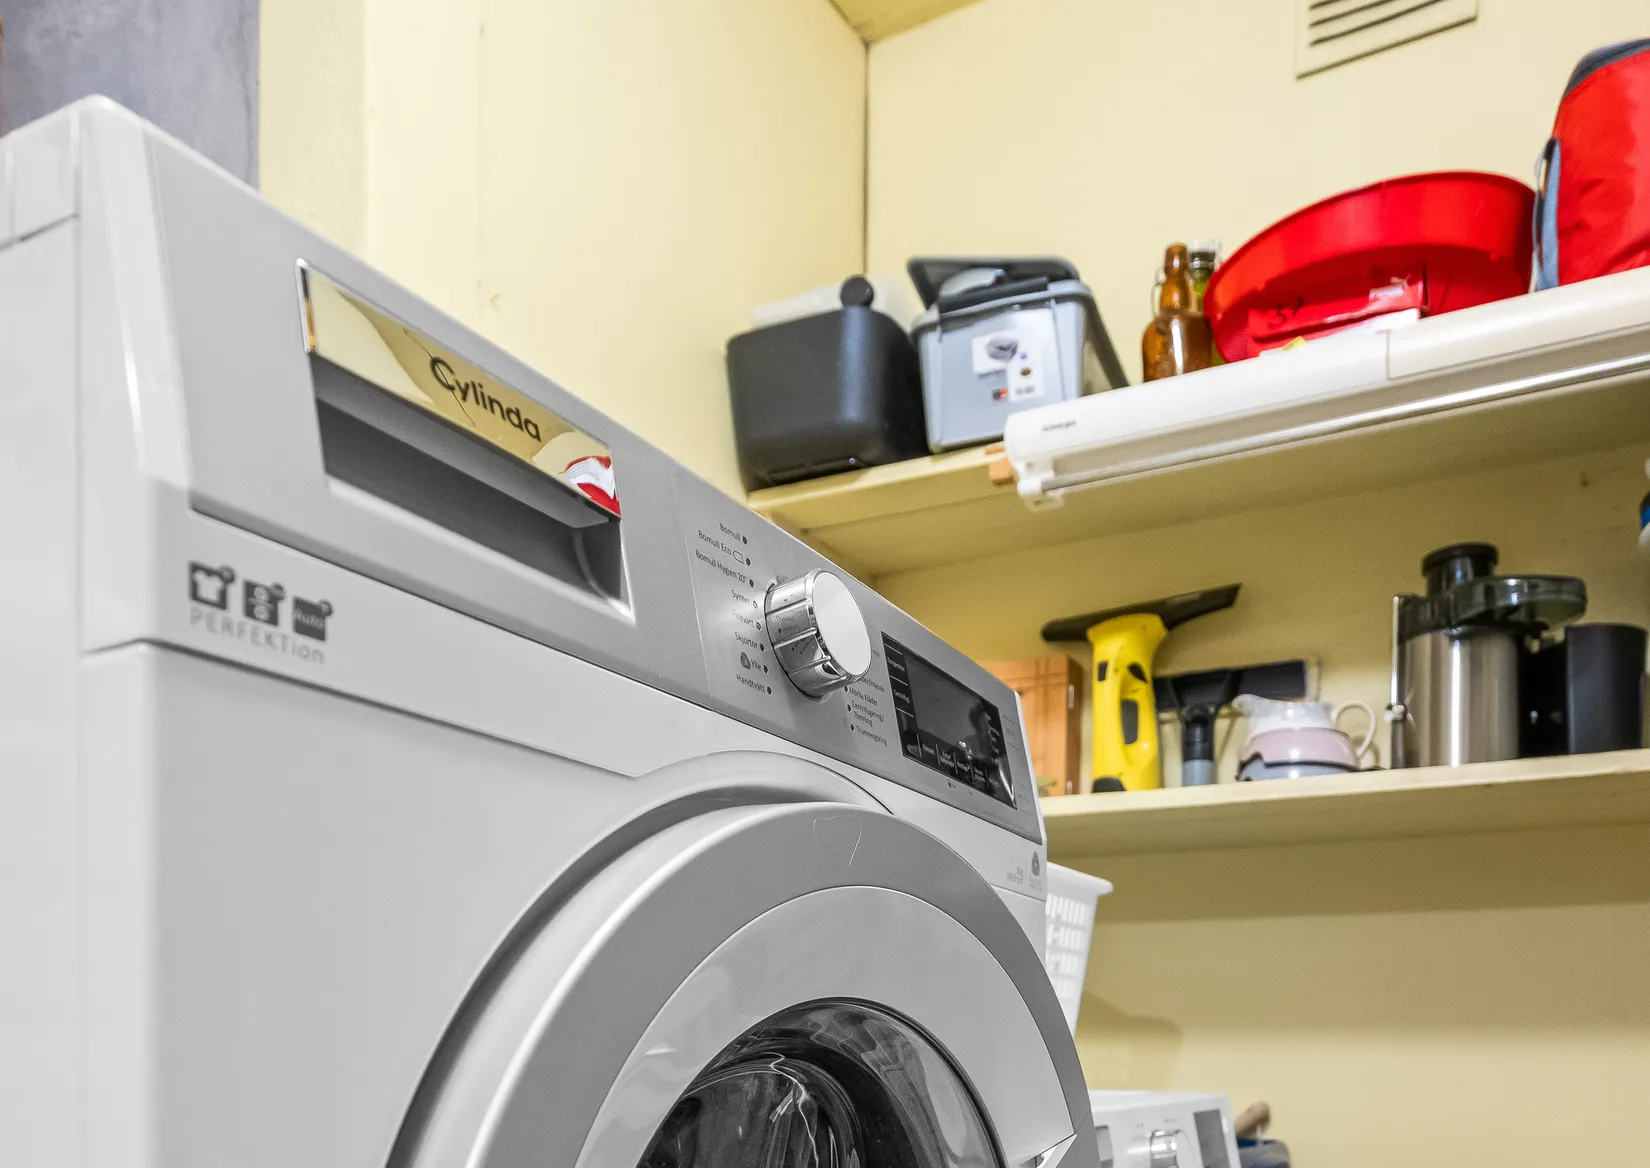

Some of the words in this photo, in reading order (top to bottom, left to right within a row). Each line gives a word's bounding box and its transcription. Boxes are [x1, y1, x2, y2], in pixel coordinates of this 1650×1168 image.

[429, 356, 542, 442] Cylinda
[697, 529, 720, 549] Bomull
[720, 542, 732, 556] Eco
[719, 522, 741, 542] Bomull
[695, 549, 717, 568] Bomull
